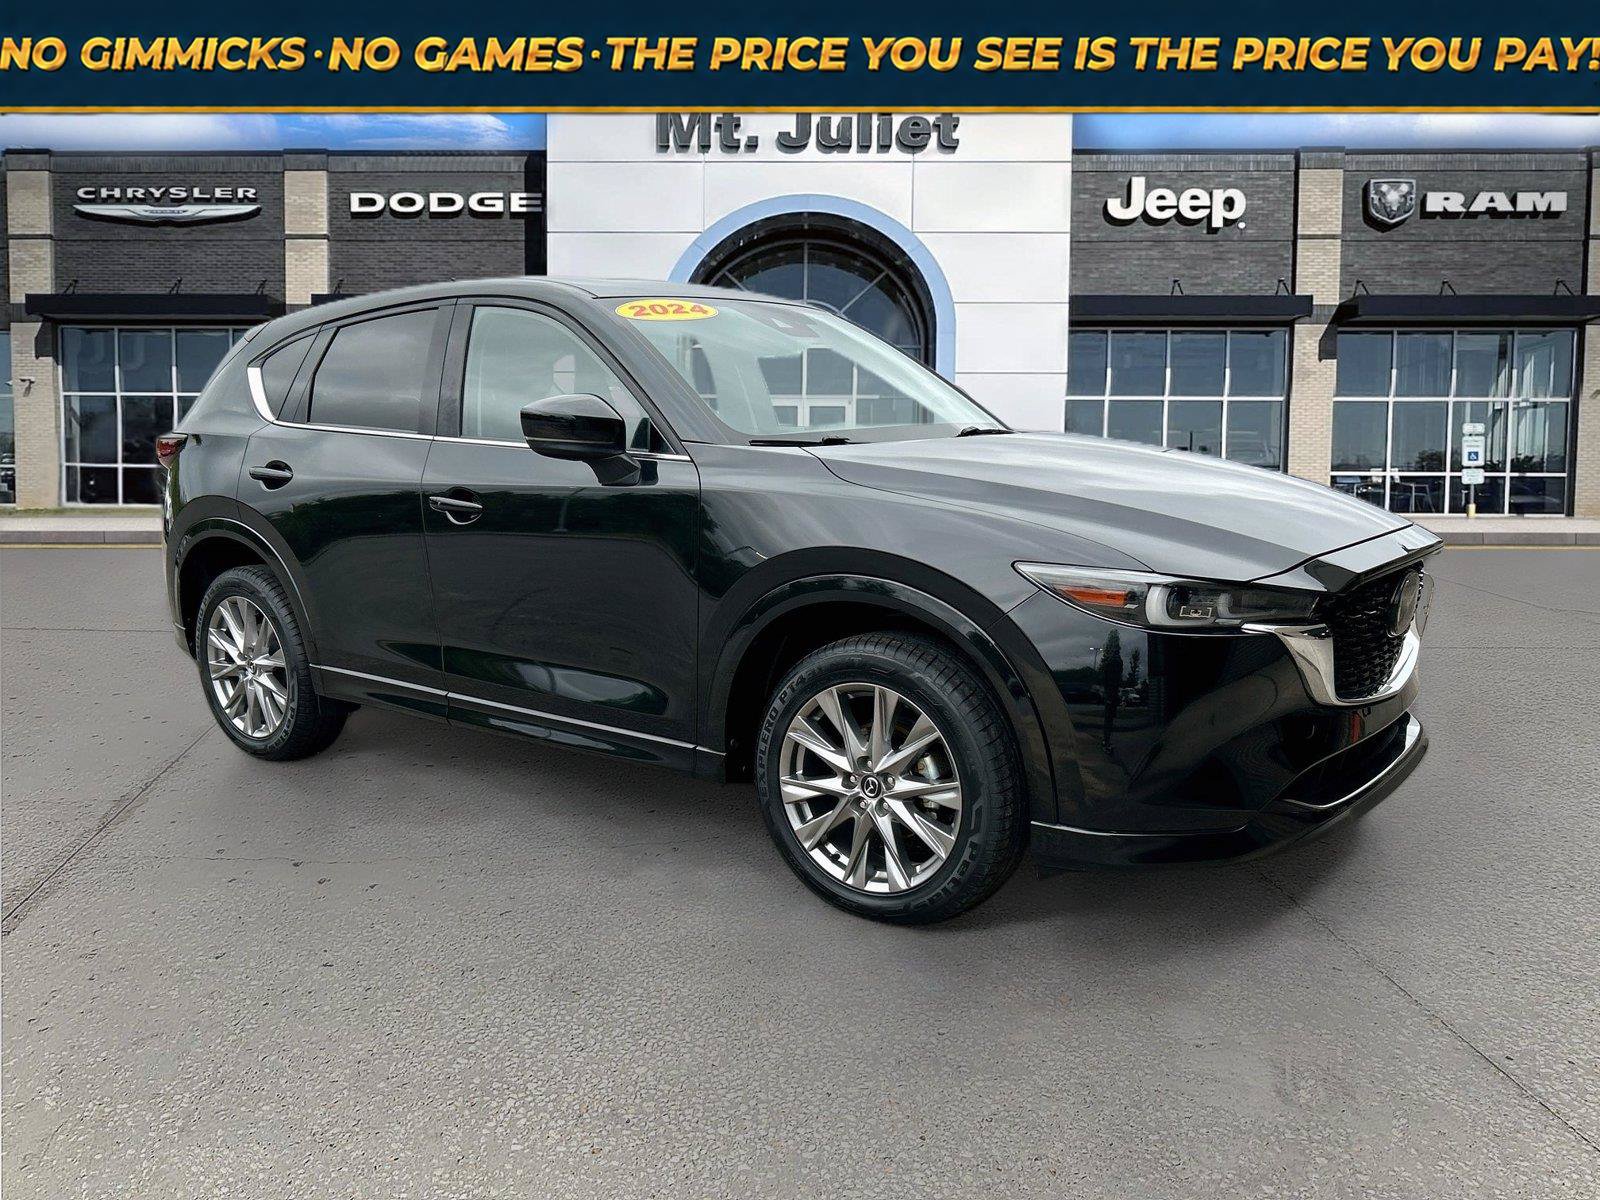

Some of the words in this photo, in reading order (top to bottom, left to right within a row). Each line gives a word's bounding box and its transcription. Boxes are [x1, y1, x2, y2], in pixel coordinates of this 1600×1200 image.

[655, 112, 758, 151] Mt.
[775, 112, 961, 153] Juliet
[76, 186, 258, 201] CHRYSLER
[349, 191, 543, 214] DODGE
[1106, 175, 1247, 229] Jeep
[1423, 191, 1569, 215] RAM
[628, 303, 710, 317] 2024
